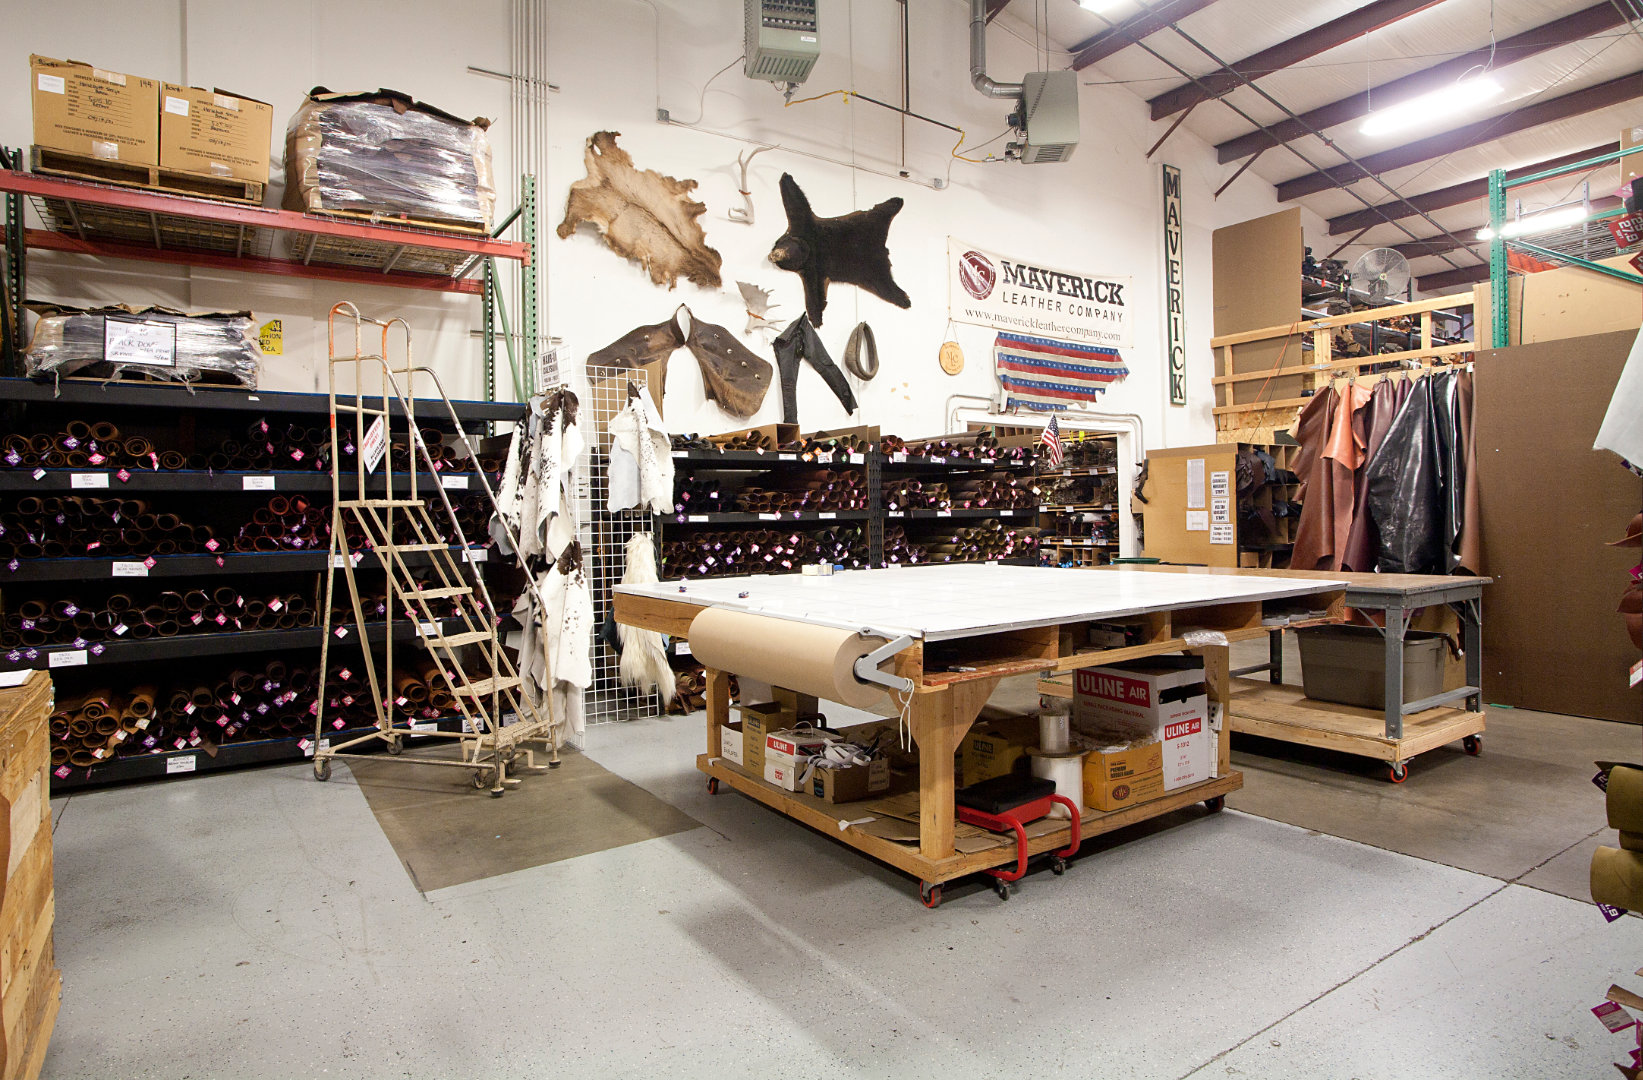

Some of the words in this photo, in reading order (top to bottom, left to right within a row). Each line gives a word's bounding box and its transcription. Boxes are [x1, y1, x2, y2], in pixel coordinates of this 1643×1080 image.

[1618, 220, 1638, 242] 27.9
[1000, 260, 1125, 306] MAVERICK
[1166, 172, 1184, 400] MAVERICK
[1002, 292, 1062, 312] LEATHER
[1068, 304, 1123, 323] COMPANY
[965, 308, 1121, 341] www.maverickleathercompany.com
[1080, 674, 1125, 699] ULINE
[1129, 687, 1147, 700] AIR
[1166, 722, 1189, 738] ULINE
[1191, 721, 1200, 730] AIR
[774, 740, 787, 751] ULINE
